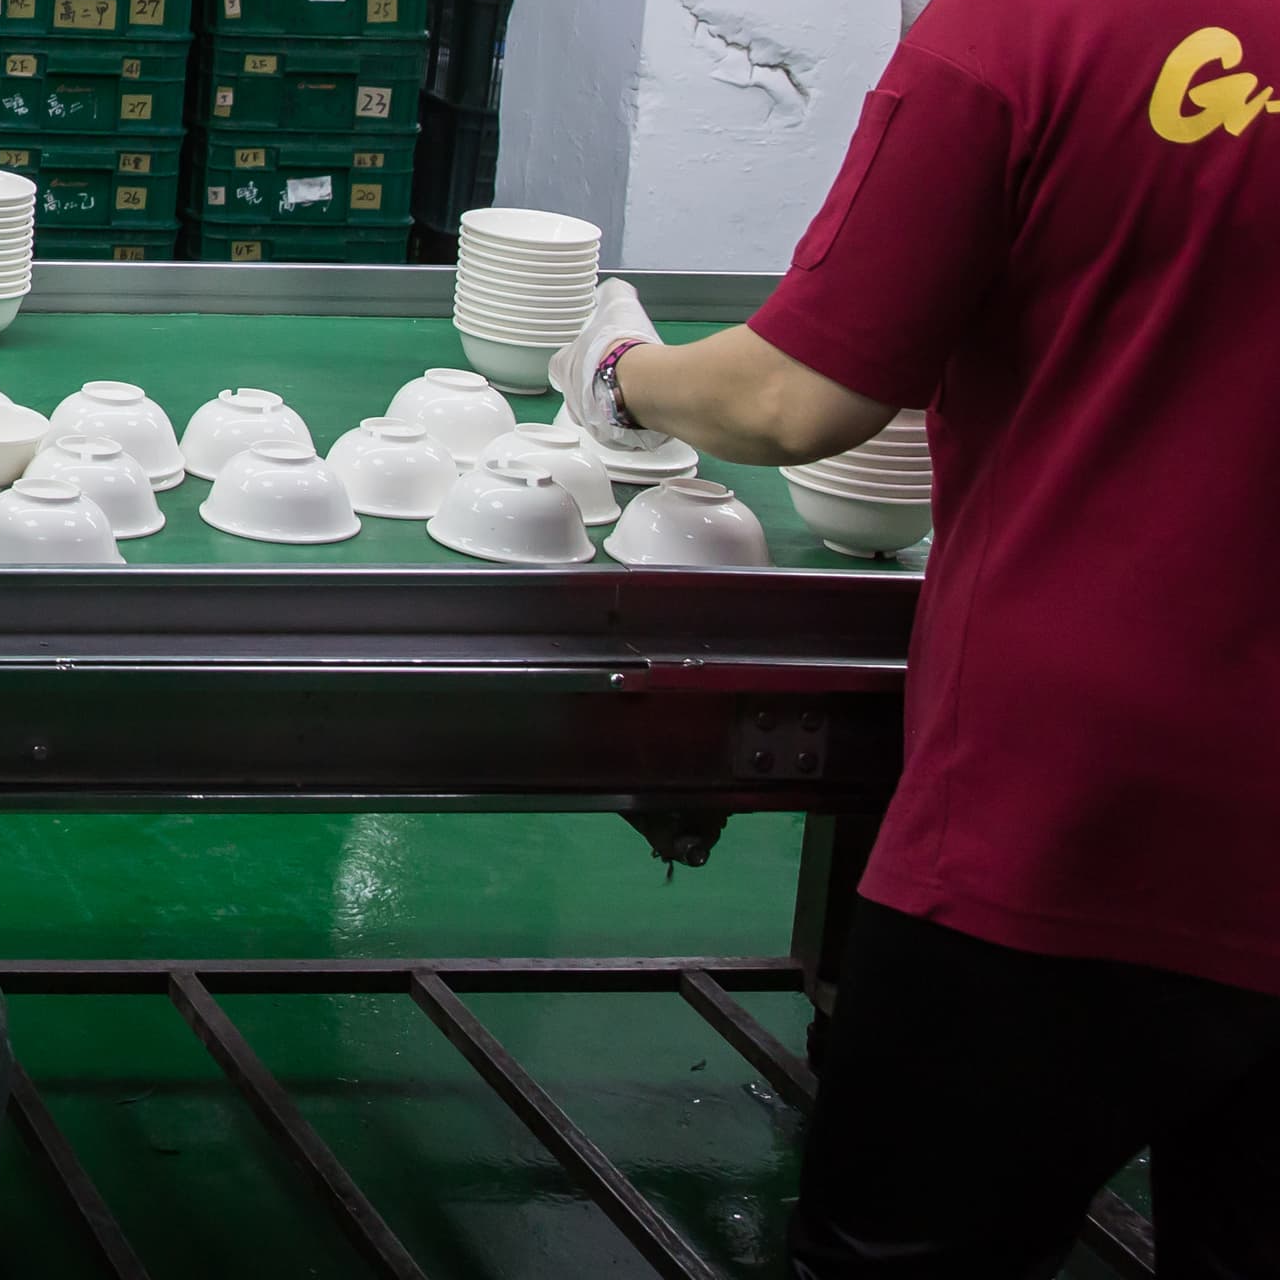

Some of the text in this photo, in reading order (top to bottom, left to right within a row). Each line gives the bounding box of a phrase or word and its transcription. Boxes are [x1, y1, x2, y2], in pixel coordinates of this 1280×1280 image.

[128, 101, 148, 118] 27
[360, 92, 387, 115] 23
[123, 191, 142, 206] 26
